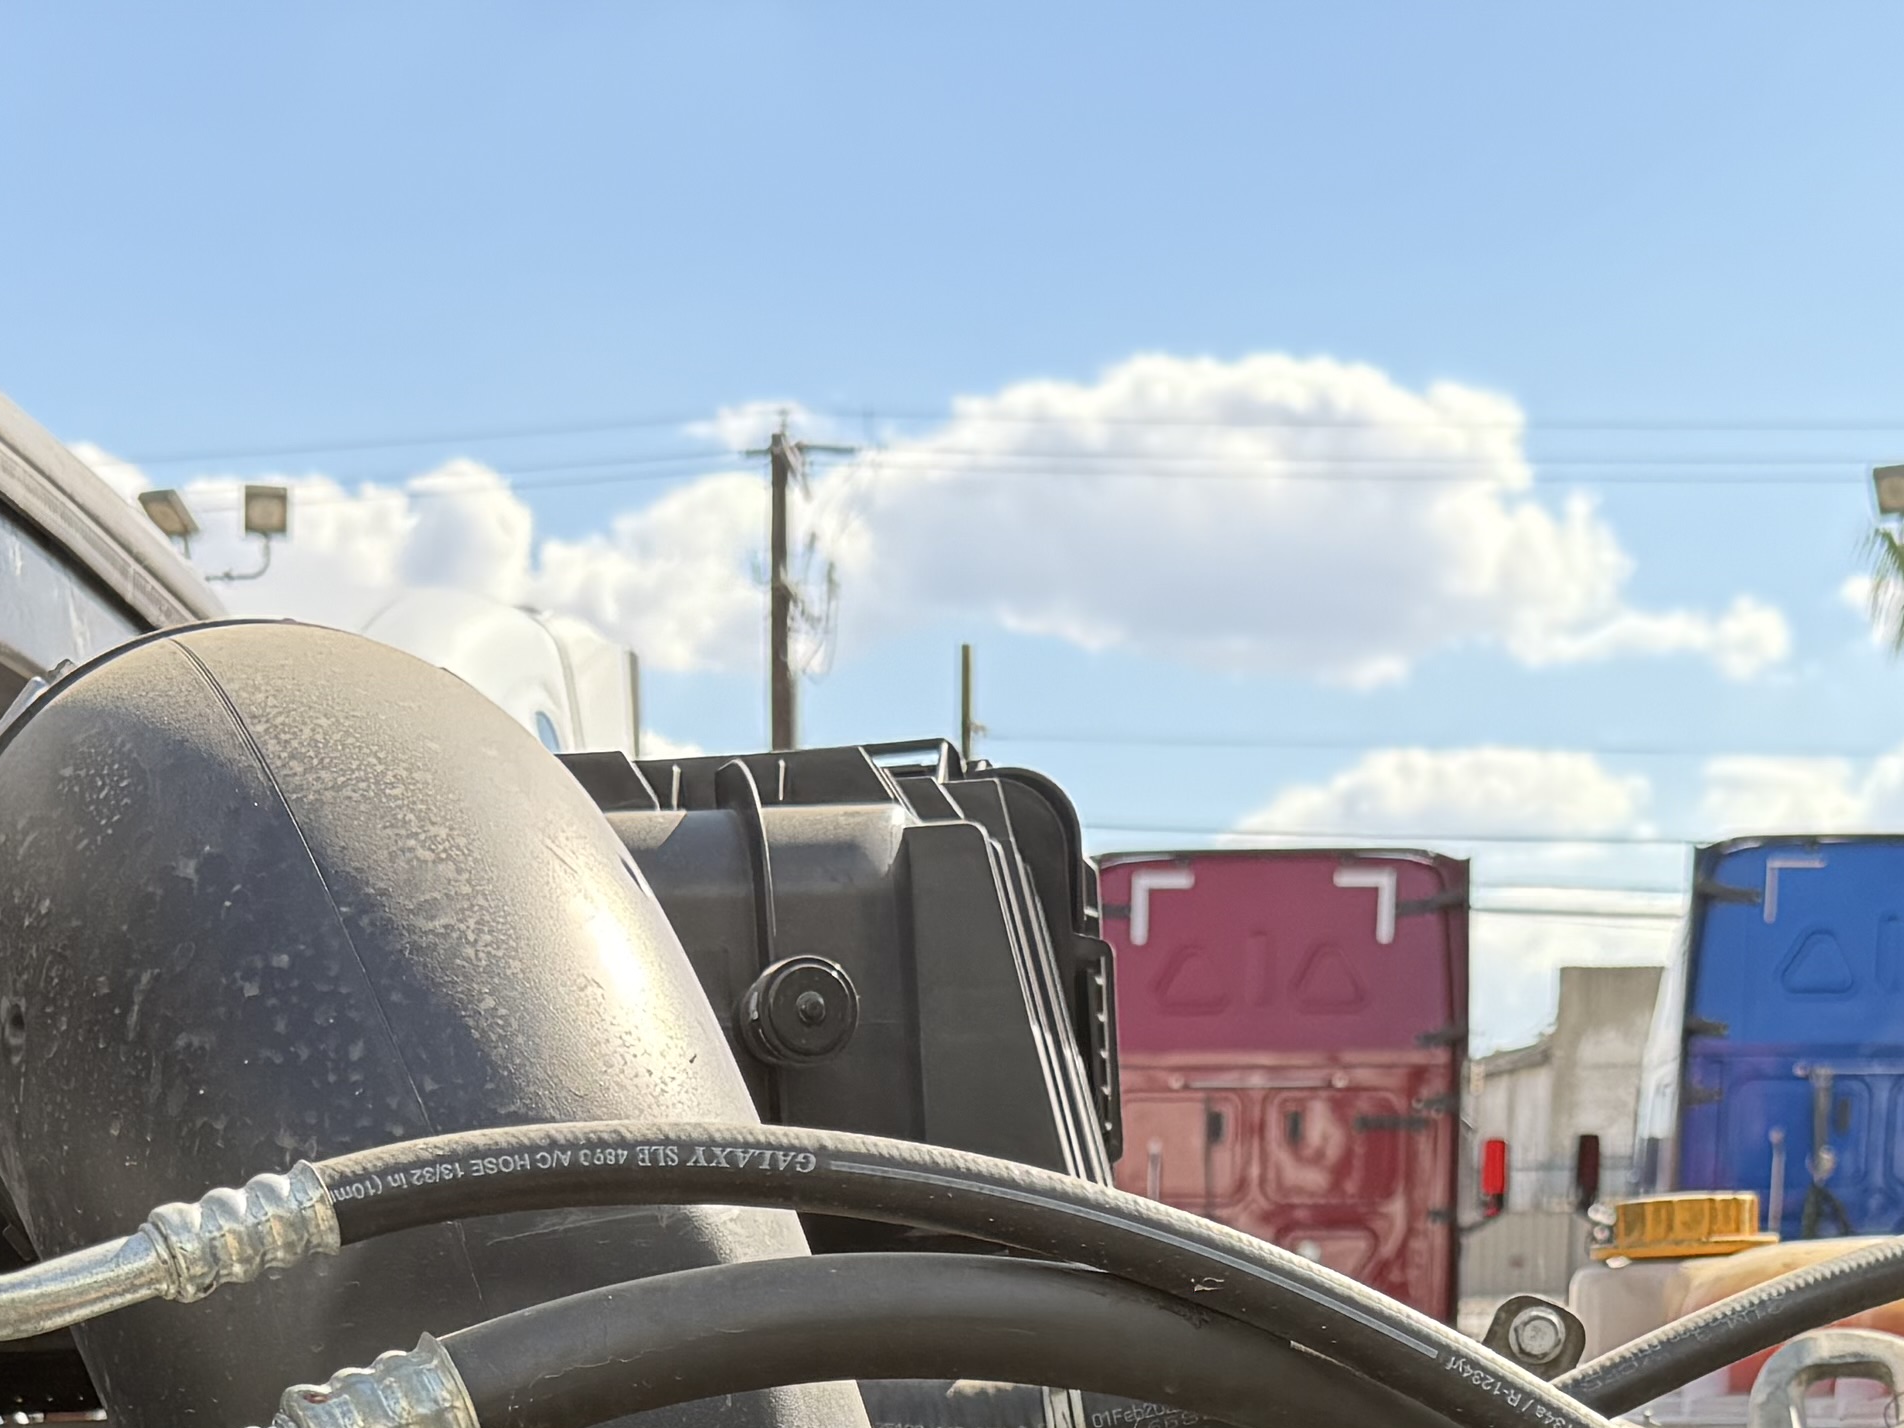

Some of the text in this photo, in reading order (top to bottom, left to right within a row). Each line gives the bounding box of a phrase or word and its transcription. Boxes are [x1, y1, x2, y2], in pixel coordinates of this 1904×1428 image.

[470, 1153, 530, 1176] HOSE
[536, 1150, 572, 1169] A/C
[636, 1145, 679, 1167] SLE
[686, 1145, 817, 1173] GALAXY
[390, 1172, 408, 1189] in
[410, 1163, 465, 1187] 13/32
[1445, 1355, 1522, 1408] R-1234yf
